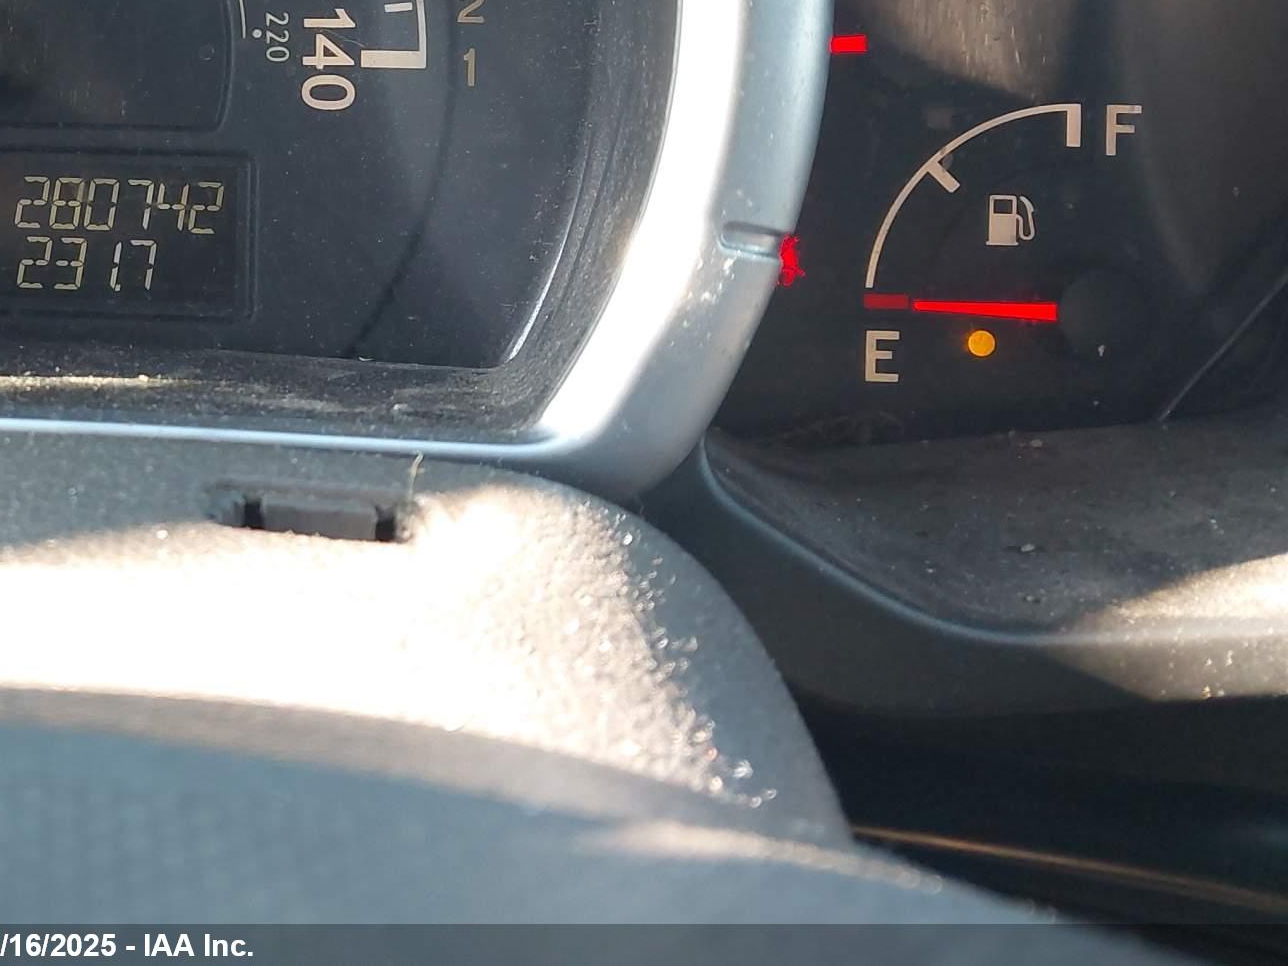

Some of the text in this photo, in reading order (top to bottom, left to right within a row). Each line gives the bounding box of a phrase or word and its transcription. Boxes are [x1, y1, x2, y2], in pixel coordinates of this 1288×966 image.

[264, 12, 290, 63] 220
[301, 7, 357, 111] 140
[463, 48, 476, 87] 1
[1104, 104, 1143, 156] F
[14, 175, 225, 235] 280742
[864, 330, 900, 383] E
